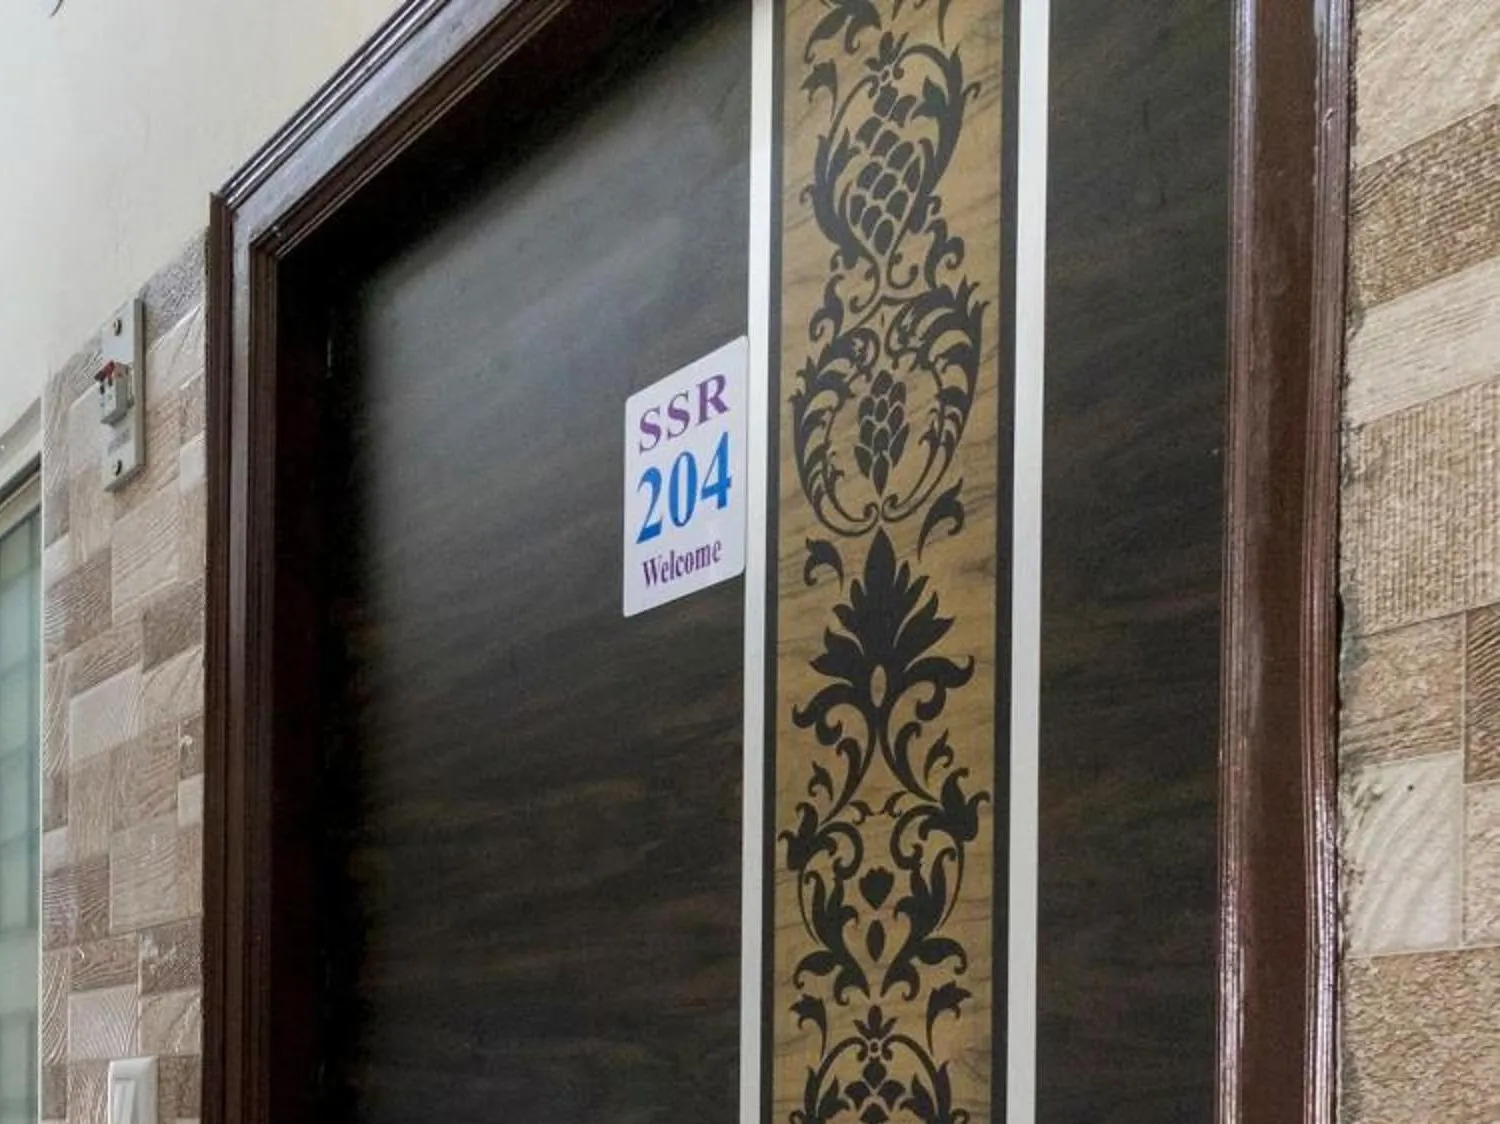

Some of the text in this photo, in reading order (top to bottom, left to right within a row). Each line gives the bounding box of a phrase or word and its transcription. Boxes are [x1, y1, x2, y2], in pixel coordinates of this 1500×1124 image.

[638, 373, 730, 455] SSR
[635, 431, 733, 544] 204
[642, 539, 722, 589] Welcome
